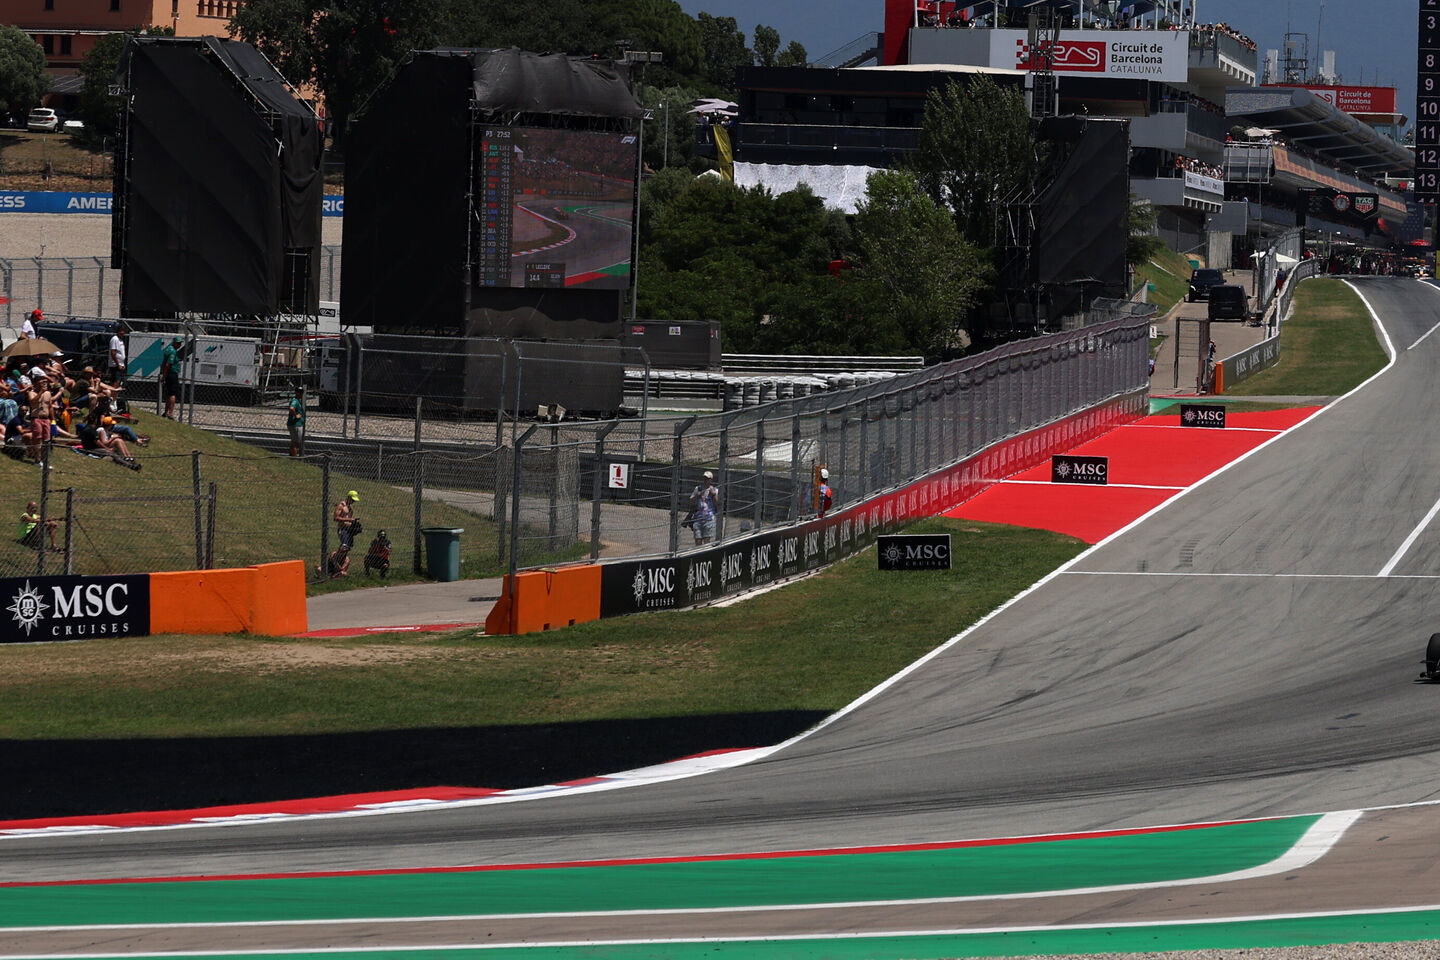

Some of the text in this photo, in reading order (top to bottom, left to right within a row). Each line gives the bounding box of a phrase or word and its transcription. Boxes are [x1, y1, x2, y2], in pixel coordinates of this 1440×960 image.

[1427, 16, 1436, 29] 3
[1112, 42, 1163, 53] Circuit de
[1111, 54, 1162, 64] Barcelona
[1426, 54, 1434, 67] 8
[1110, 65, 1162, 74] CATALUNYA
[1425, 78, 1434, 90] 9
[1420, 102, 1437, 115] 10
[1420, 126, 1435, 139] 11
[1420, 150, 1436, 163] 12
[1419, 174, 1436, 187] 13
[1197, 410, 1224, 421] MSC
[1073, 463, 1106, 475] MSC
[784, 537, 798, 563] MSC
[905, 544, 947, 559] MSC
[756, 544, 772, 570] MSC
[728, 552, 743, 580] MSC
[647, 567, 675, 594] MSC
[695, 560, 712, 588] MSC
[51, 583, 128, 618] MSC
[646, 598, 675, 607] CRUISES
[52, 622, 129, 636] CRUISES
